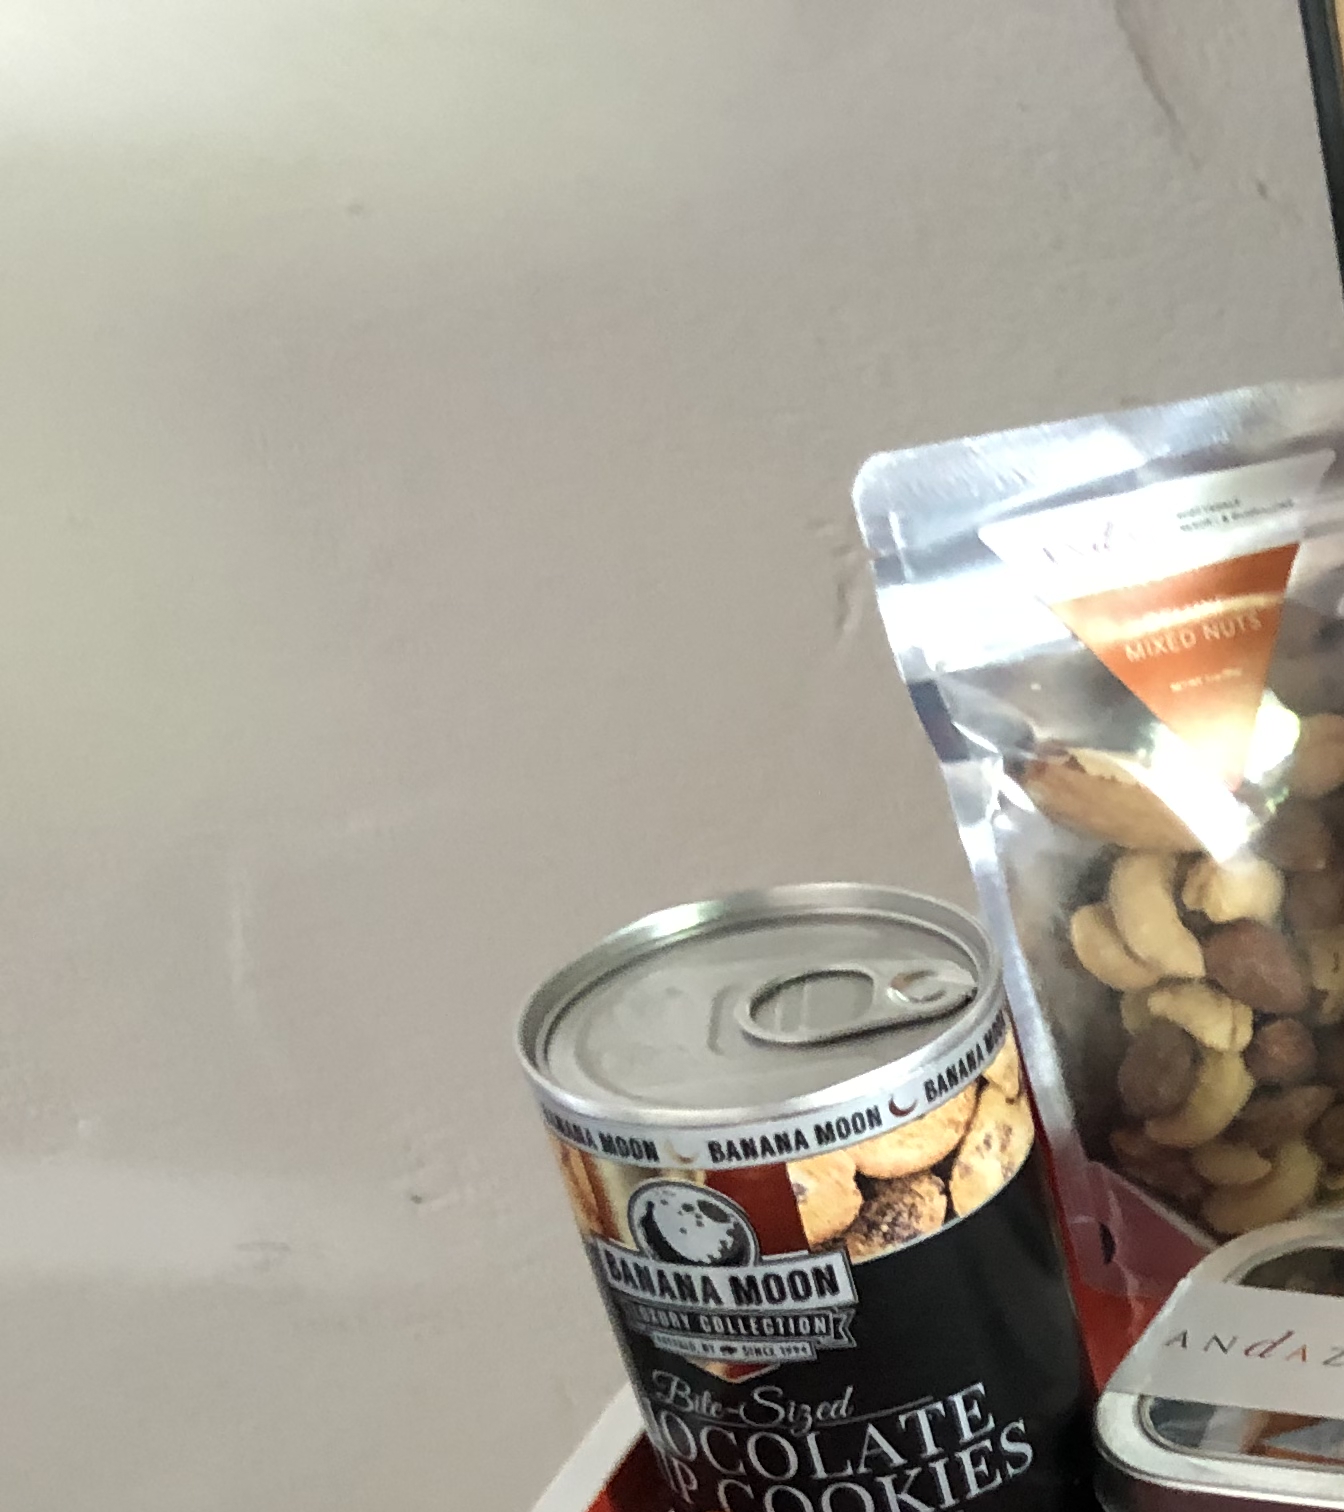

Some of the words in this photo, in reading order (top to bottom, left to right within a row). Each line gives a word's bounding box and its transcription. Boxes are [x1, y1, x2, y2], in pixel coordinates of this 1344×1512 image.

[1124, 629, 1198, 664] MIXED
[1202, 611, 1262, 642] NUTS
[923, 1043, 986, 1103] BANANA
[598, 1131, 661, 1163] MOON
[707, 1127, 810, 1164] BANANA
[813, 1105, 884, 1146] MOON
[603, 1248, 723, 1306] BANANA
[727, 1263, 842, 1307] MOON
[700, 1313, 829, 1337] COLLECTION
[651, 1368, 854, 1436] Bite-Sized
[660, 1381, 997, 1480] OCOLATE
